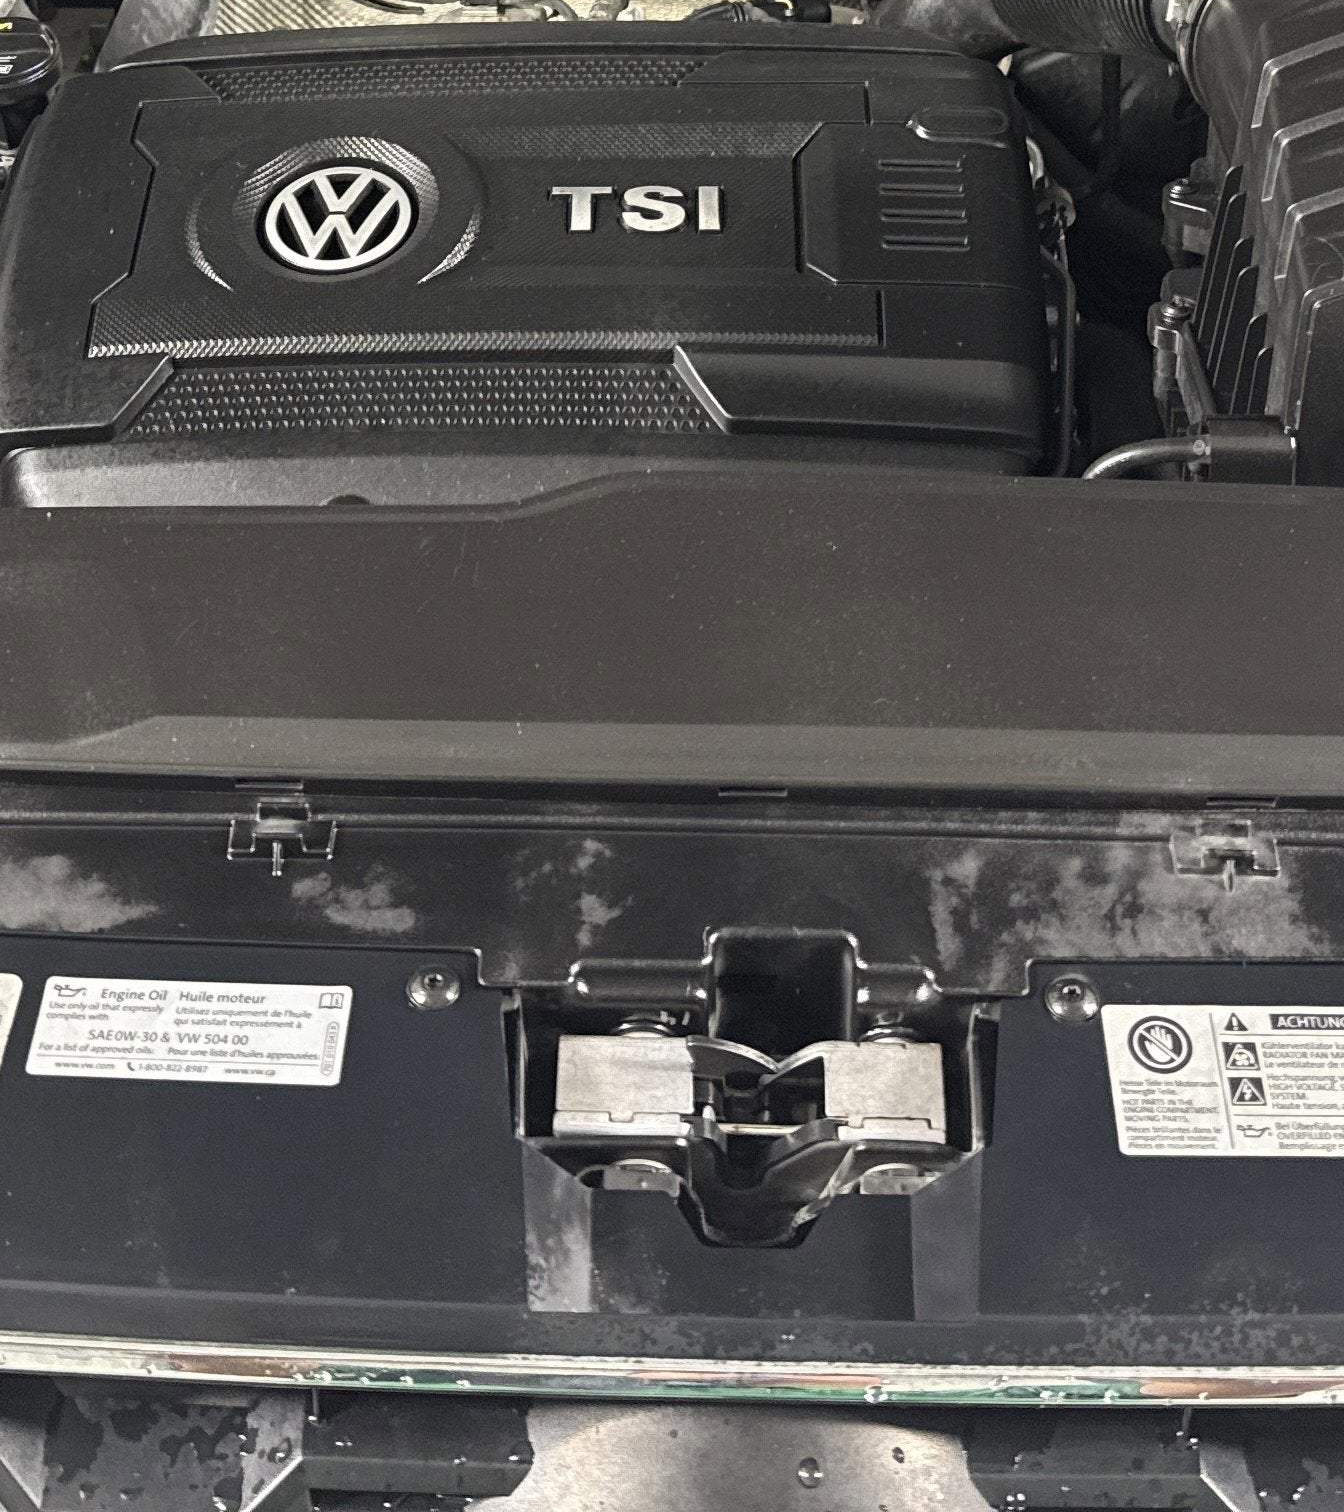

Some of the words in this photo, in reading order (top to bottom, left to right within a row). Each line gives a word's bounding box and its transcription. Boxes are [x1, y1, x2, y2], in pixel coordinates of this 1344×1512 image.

[550, 185, 724, 234] TSI
[100, 988, 146, 1003] Engine
[148, 989, 168, 1001] Oil
[179, 991, 214, 1003] Huile
[216, 992, 266, 1005] moteur
[49, 1001, 66, 1009] Use
[67, 1001, 87, 1012] only
[101, 1002, 120, 1011] that
[121, 1004, 165, 1015] expressly
[175, 1006, 210, 1016] Utilisez
[211, 1007, 269, 1019] uniquement
[283, 1009, 313, 1019] l'huile
[46, 1012, 86, 1021] complies
[88, 1013, 109, 1021] with
[173, 1018, 189, 1028] qui
[191, 1018, 227, 1027] satisfait
[160, 1032, 171, 1043] &
[177, 1032, 201, 1044] VW
[203, 1033, 229, 1045] 504
[231, 1034, 249, 1046] 00
[38, 1041, 53, 1050] For
[90, 1044, 134, 1055] approved
[167, 1047, 189, 1056] Pour
[209, 1048, 228, 1057] liste
[229, 1049, 264, 1058] d'huiles
[1262, 1051, 1308, 1059] RADIATOR
[1310, 1051, 1329, 1059] FAN
[54, 1061, 115, 1070] www.vw.com
[224, 1067, 276, 1077] www.vw.ca
[1271, 1102, 1301, 1110] Haute
